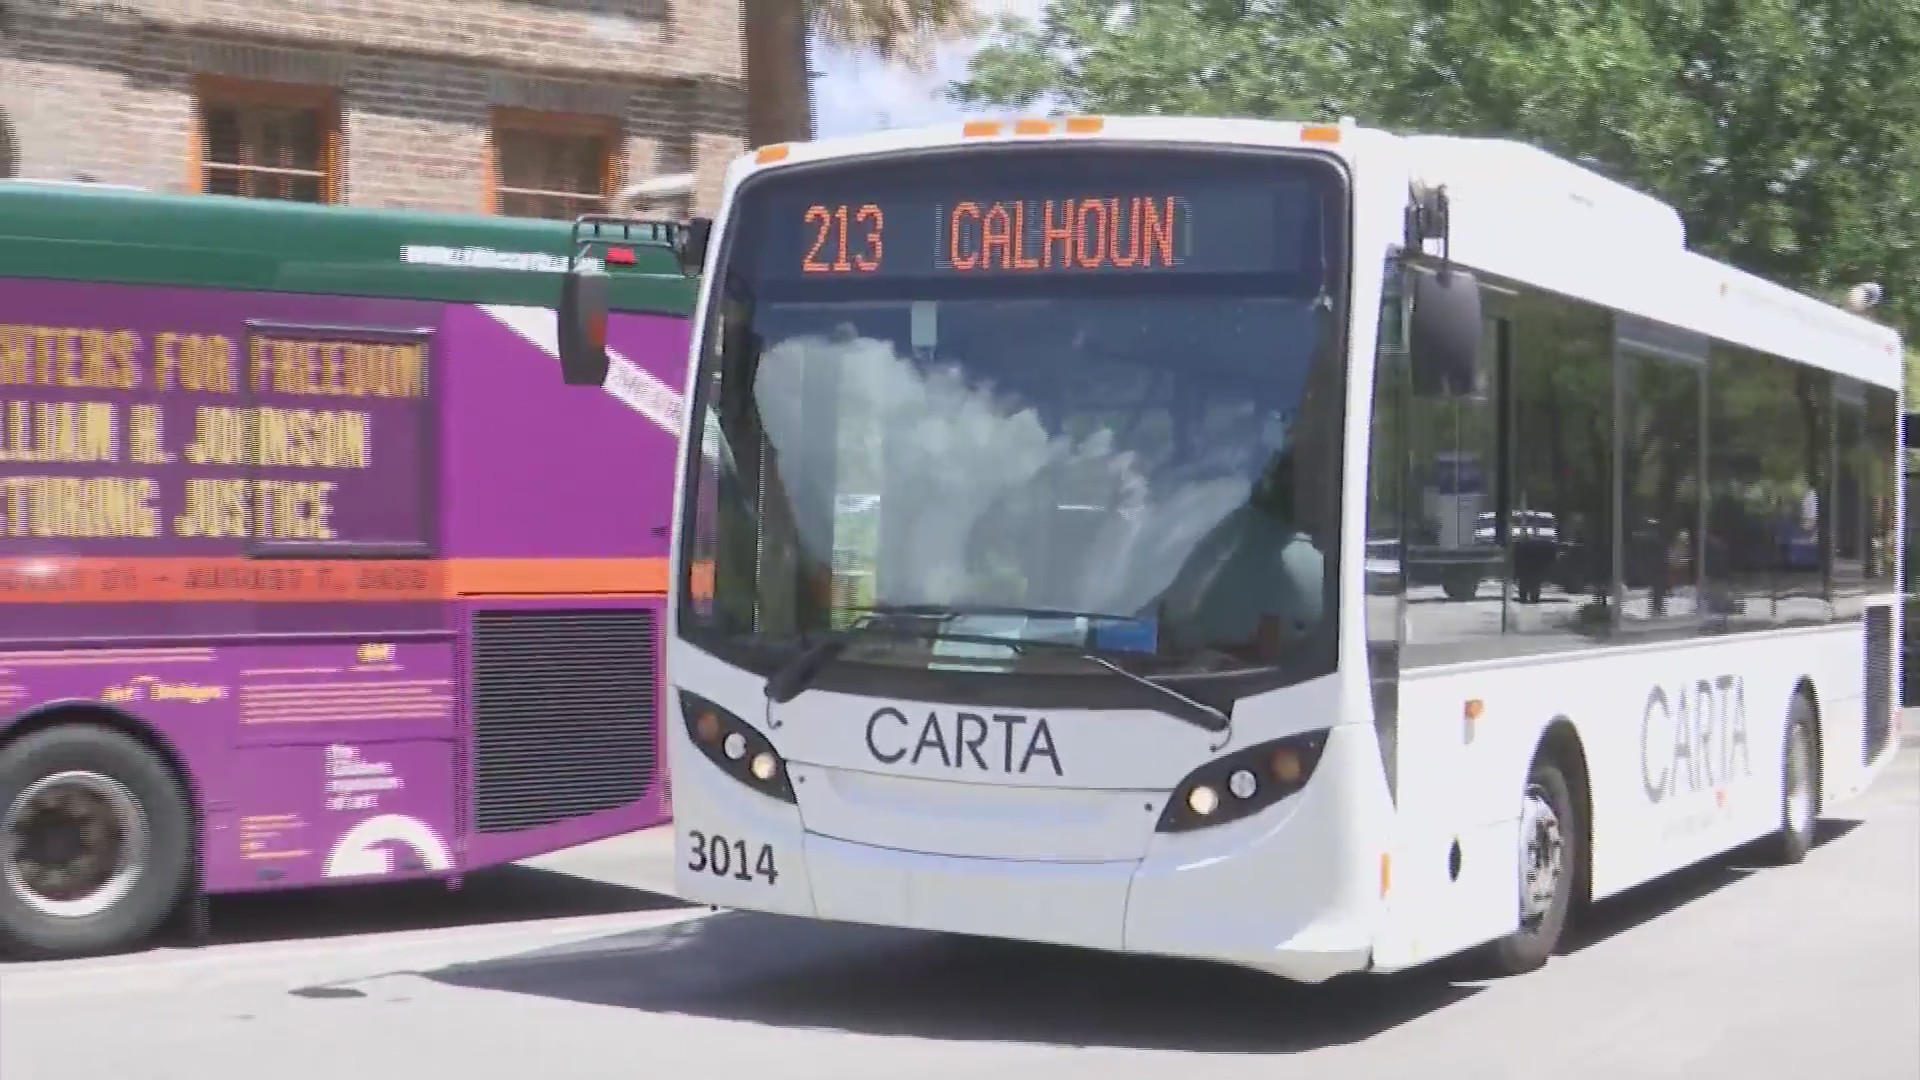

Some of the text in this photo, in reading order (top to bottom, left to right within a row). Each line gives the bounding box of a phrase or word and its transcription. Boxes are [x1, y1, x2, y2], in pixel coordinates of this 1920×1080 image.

[802, 196, 1178, 273] 213 CALHOUN
[154, 331, 238, 395] FOR
[248, 334, 428, 398] FREEDOM
[185, 405, 371, 469] JOHNSON
[174, 479, 338, 539] JUSTICE
[865, 706, 1064, 776] CARTA
[1641, 674, 1752, 804] CARTA
[687, 830, 778, 886] 3014
